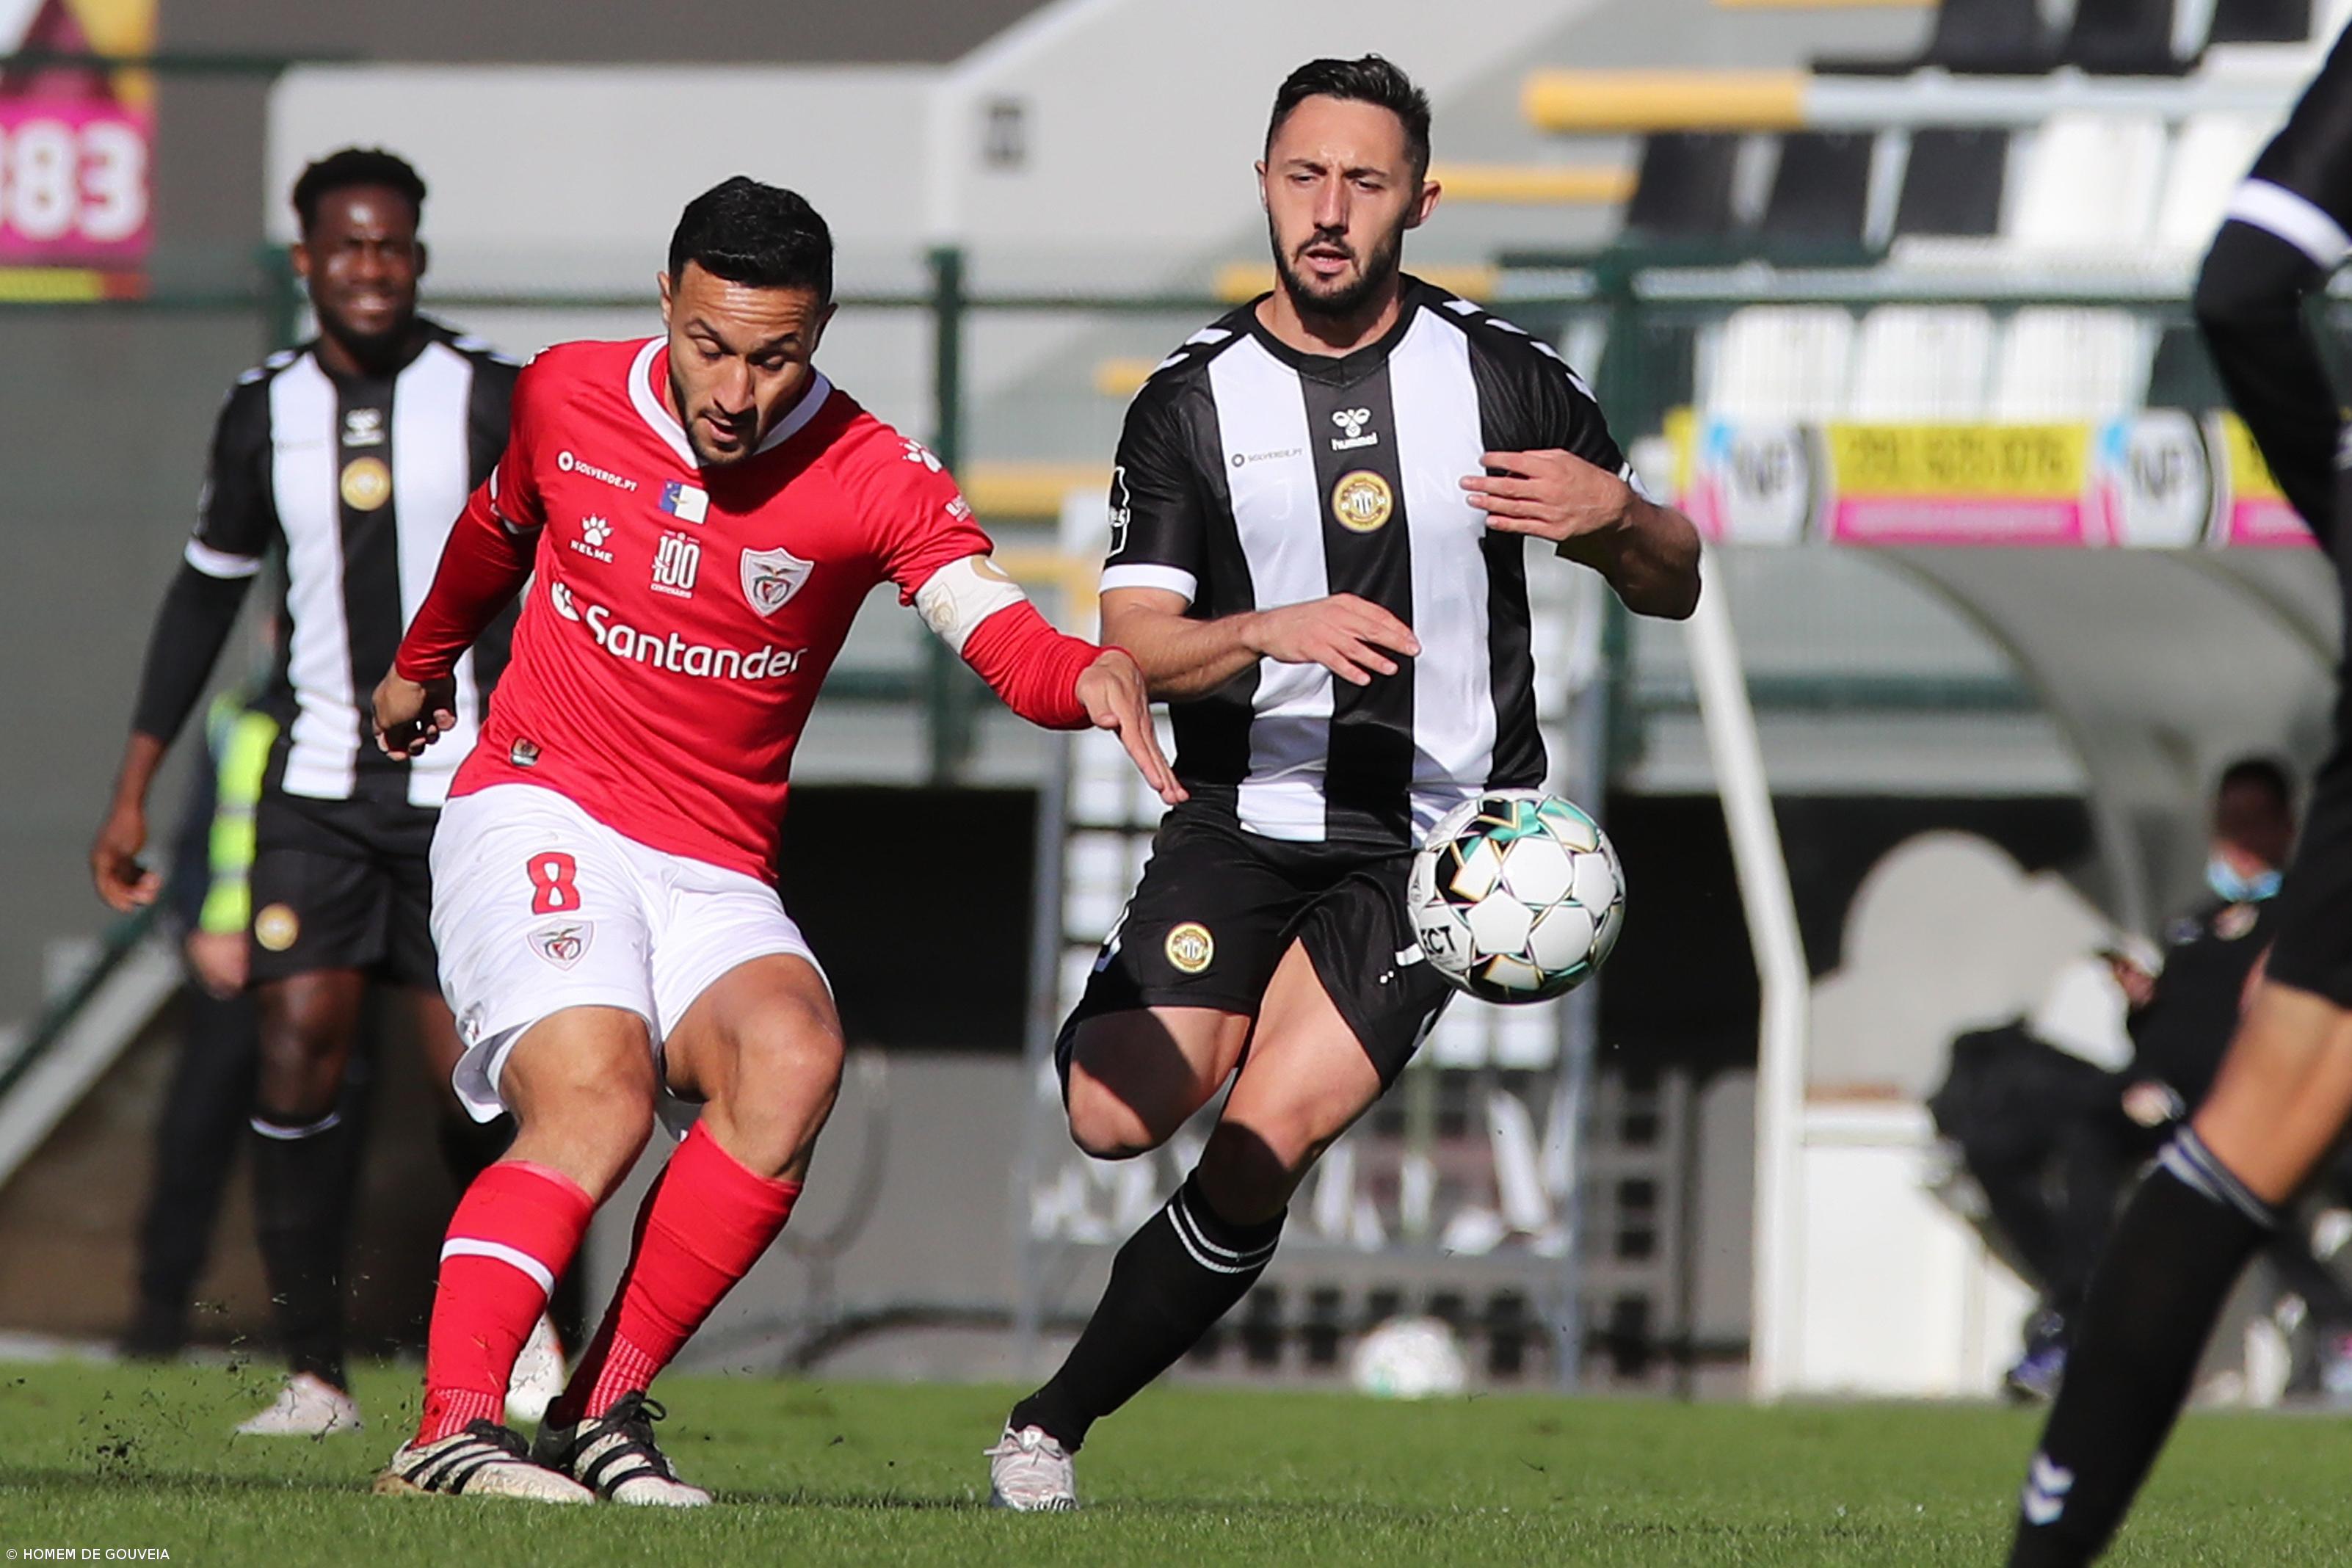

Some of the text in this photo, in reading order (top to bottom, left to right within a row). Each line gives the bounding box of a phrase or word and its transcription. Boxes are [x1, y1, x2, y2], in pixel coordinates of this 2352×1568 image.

[0, 117, 149, 242] 83
[575, 460, 638, 493] SOLVERDE.PT
[570, 540, 614, 564] KELME
[653, 535, 700, 589] 100
[586, 605, 808, 680] Santander
[526, 851, 581, 915] 8
